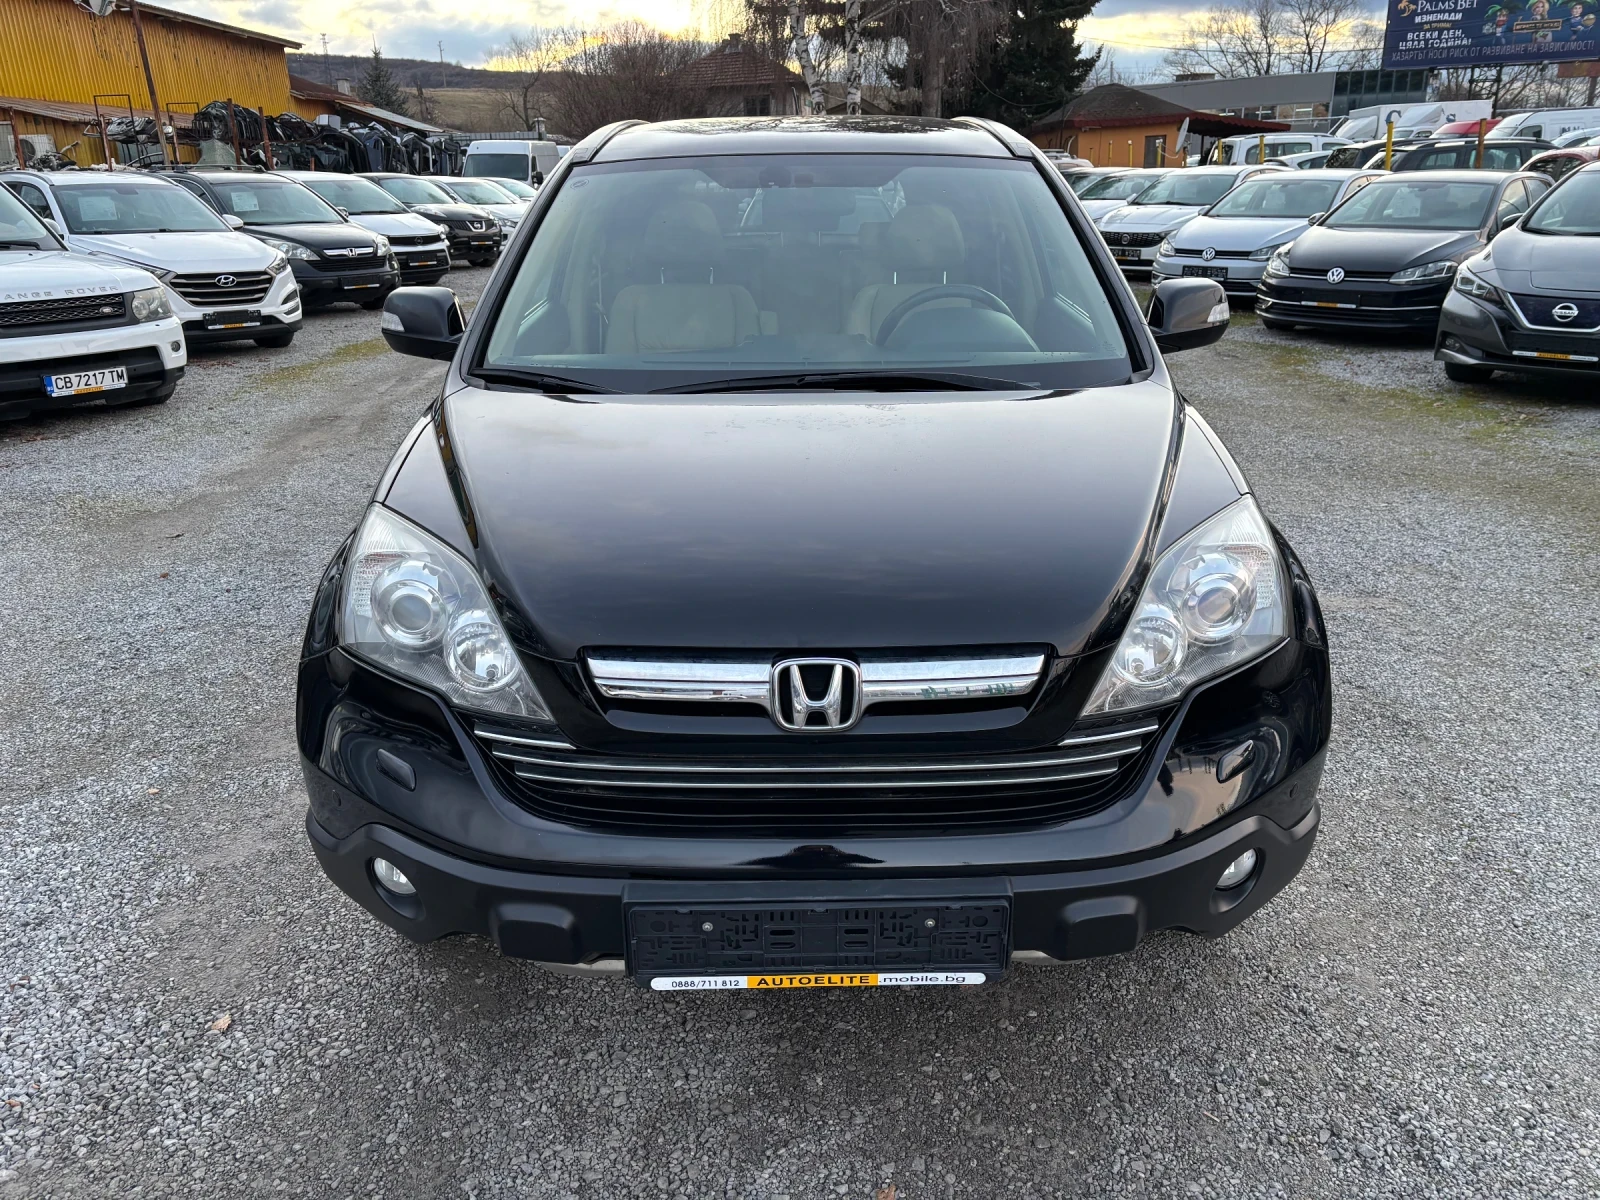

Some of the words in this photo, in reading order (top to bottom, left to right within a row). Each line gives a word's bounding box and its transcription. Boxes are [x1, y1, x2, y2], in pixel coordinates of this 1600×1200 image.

[1414, 12, 1463, 23] ИЗНЕНАДИ
[1407, 30, 1439, 40] ВСЕКИ
[1441, 29, 1465, 39] ДЕН,
[1391, 50, 1426, 61] ХАЗАРТЪТ
[1428, 48, 1448, 59] НОСИ
[1449, 47, 1468, 57] РИСК
[1470, 46, 1480, 56] ОТ
[1482, 44, 1526, 56] РАЗВИВАНЕ
[1527, 43, 1538, 53] НА
[1540, 40, 1595, 53] ЗАВИСИМОСТ!
[1399, 40, 1425, 50] ЦЯЛА
[1428, 38, 1472, 48] ГОДИНА!
[4, 292, 53, 300] ANGE
[65, 286, 119, 295] ROVER
[55, 376, 73, 390] CB
[75, 371, 105, 387] 7217
[108, 369, 125, 383] TM
[671, 979, 719, 989] 0888/711
[721, 979, 741, 988] 812
[757, 976, 870, 986] AUTOELITE
